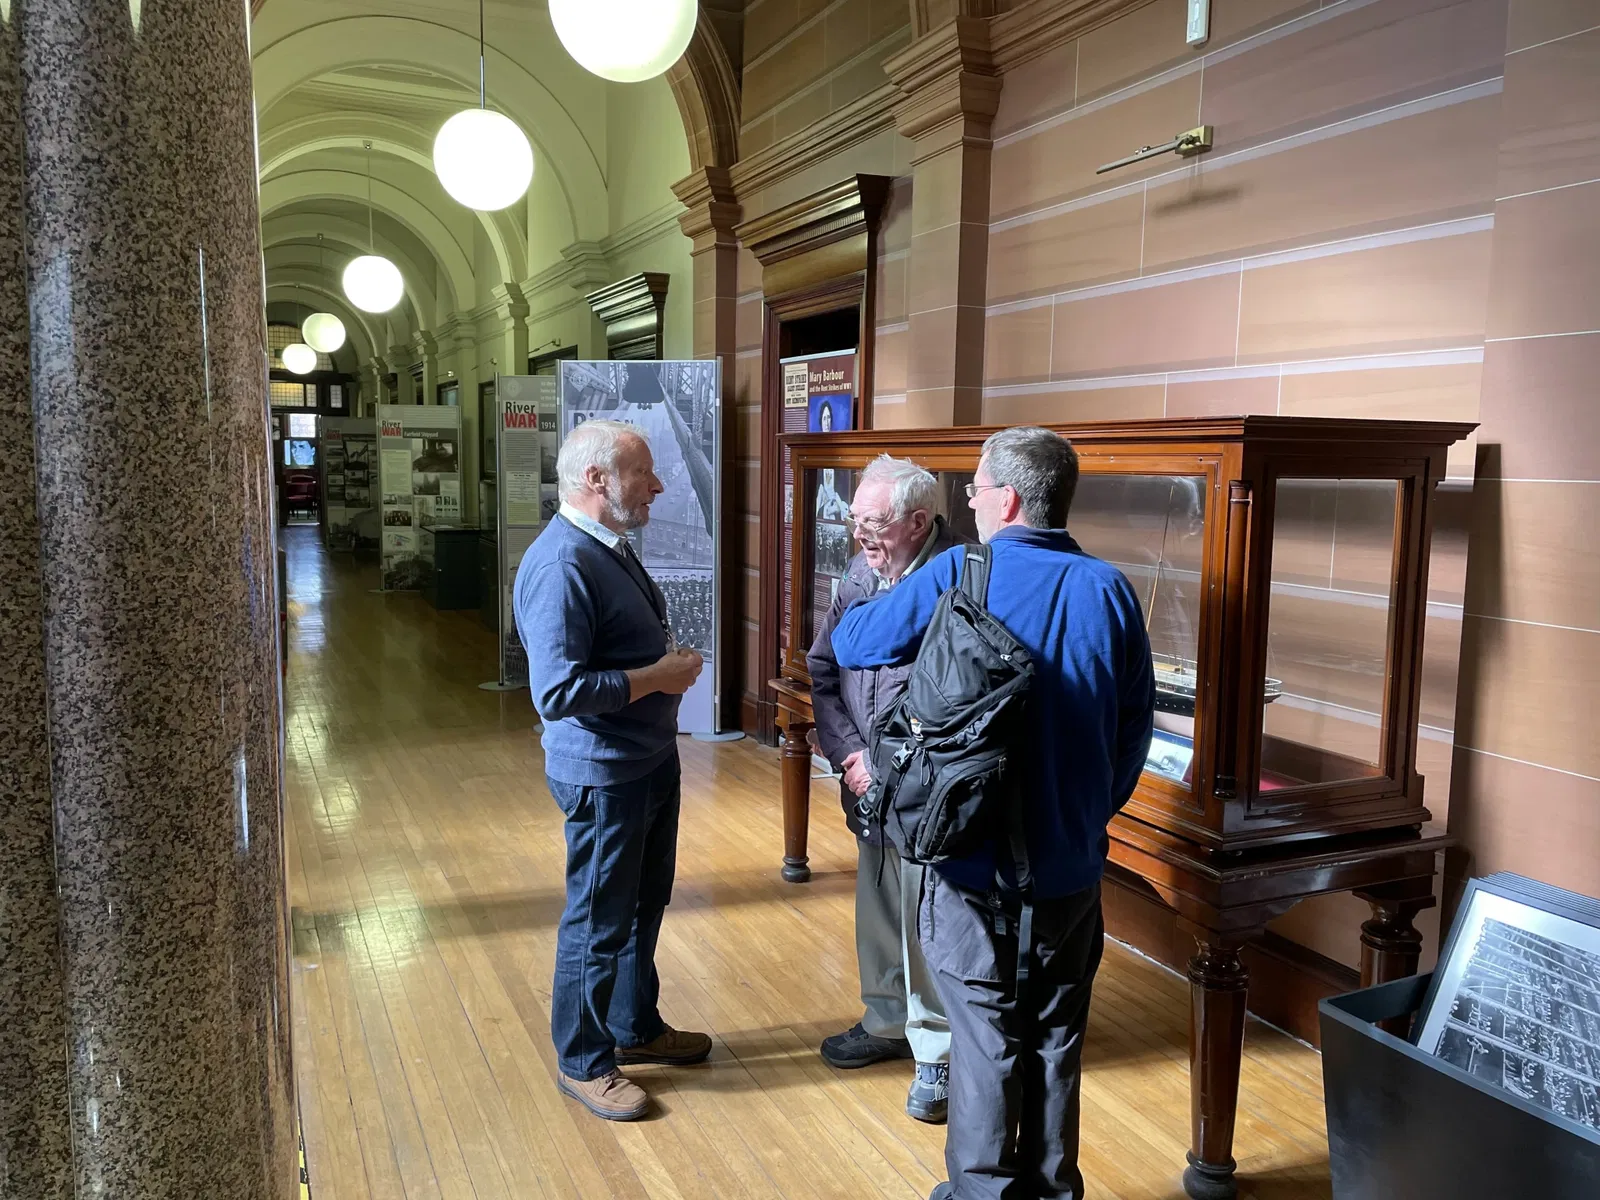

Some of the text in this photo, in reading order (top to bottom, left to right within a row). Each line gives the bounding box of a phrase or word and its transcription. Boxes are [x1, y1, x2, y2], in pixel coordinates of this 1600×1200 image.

[809, 369, 845, 384] Mary Barbour
[505, 401, 535, 414] River
[382, 420, 401, 428] River
[504, 412, 537, 428] WAR
[381, 427, 402, 437] WAR
